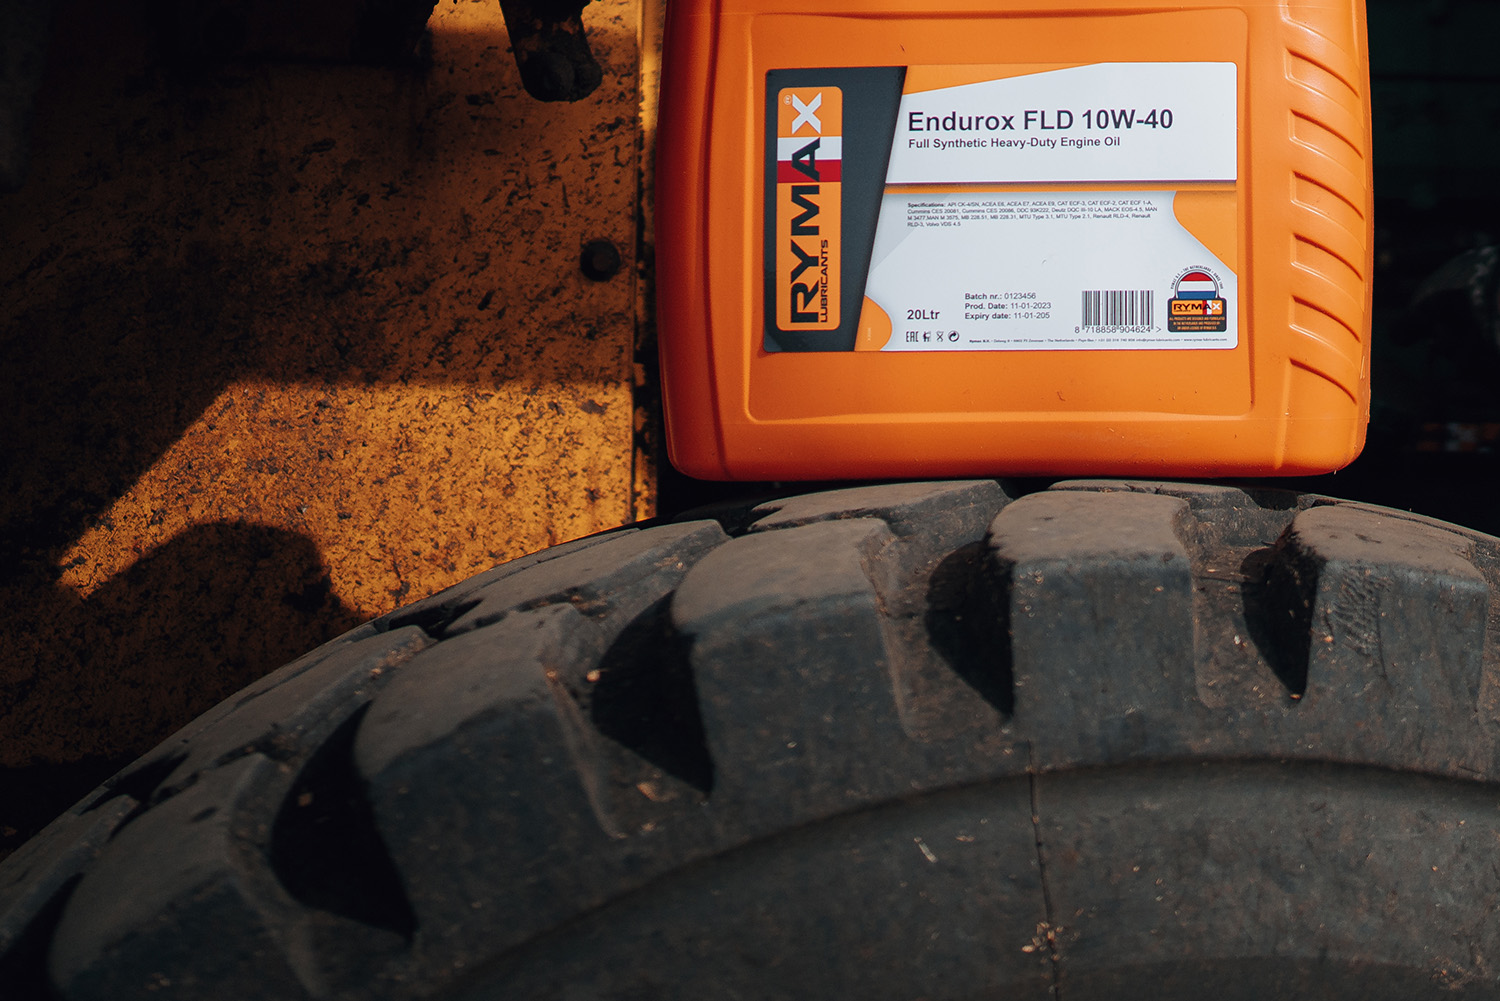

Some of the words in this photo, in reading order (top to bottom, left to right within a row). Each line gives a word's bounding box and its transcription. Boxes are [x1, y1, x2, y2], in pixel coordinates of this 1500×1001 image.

[908, 111, 1015, 131] Endurox
[1024, 109, 1074, 130] FLD
[1082, 108, 1173, 129] 10W-40
[908, 138, 930, 148] Full
[933, 138, 987, 150] Synthetic
[991, 137, 1057, 150] Heavy-Duty
[1060, 137, 1101, 149] Engine
[1104, 136, 1120, 146] Oil
[790, 92, 822, 323] RYMAX
[820, 240, 829, 323] LUBRICANTS
[1004, 292, 1037, 300] 0123456
[1173, 303, 1221, 311] RYMAX
[906, 309, 940, 320] 20Ltr
[965, 312, 989, 320] Expiry
